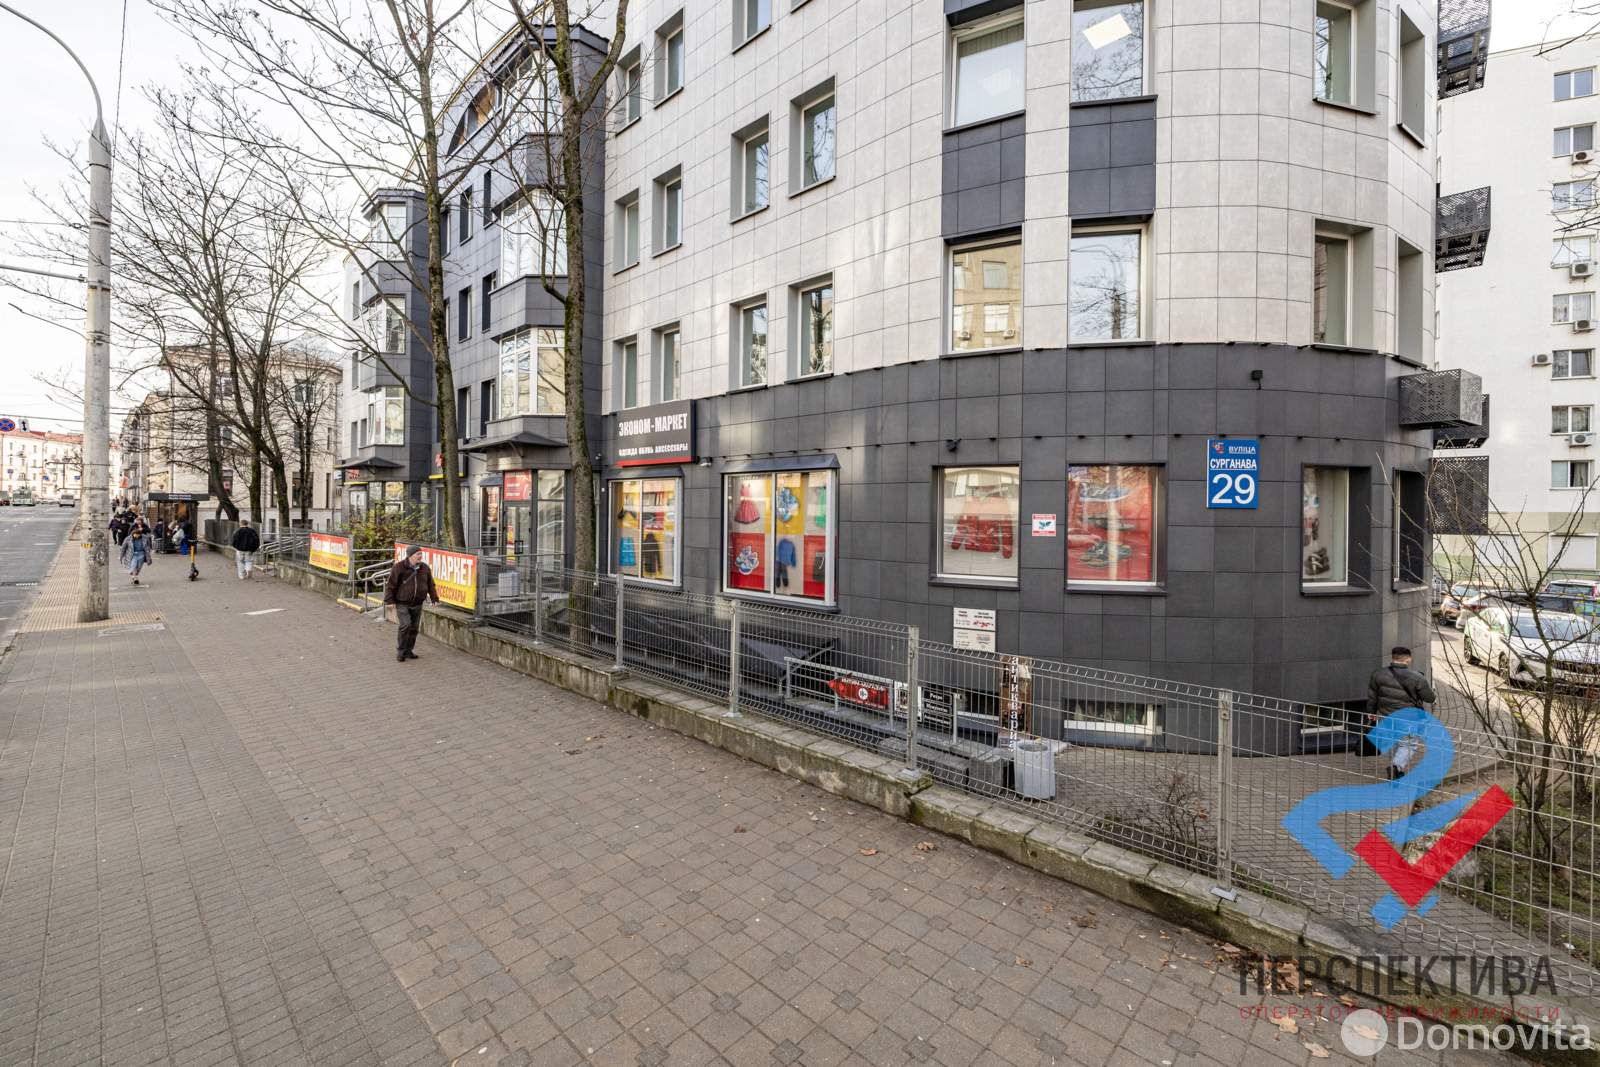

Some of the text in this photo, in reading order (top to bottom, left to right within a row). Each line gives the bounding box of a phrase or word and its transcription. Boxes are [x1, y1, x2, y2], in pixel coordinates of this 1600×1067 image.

[618, 413, 688, 437] ЭКОНОМ-МАРКЕТ
[618, 443, 689, 457] ОДЕЖДА ОБУВЬ АКСЕССУАРЫ
[1228, 446, 1256, 454] ВУЛІЦА
[1210, 458, 1257, 469] СУРГАНАВА
[1211, 473, 1256, 505] 29
[435, 584, 467, 604] КСЕССУАРЫ
